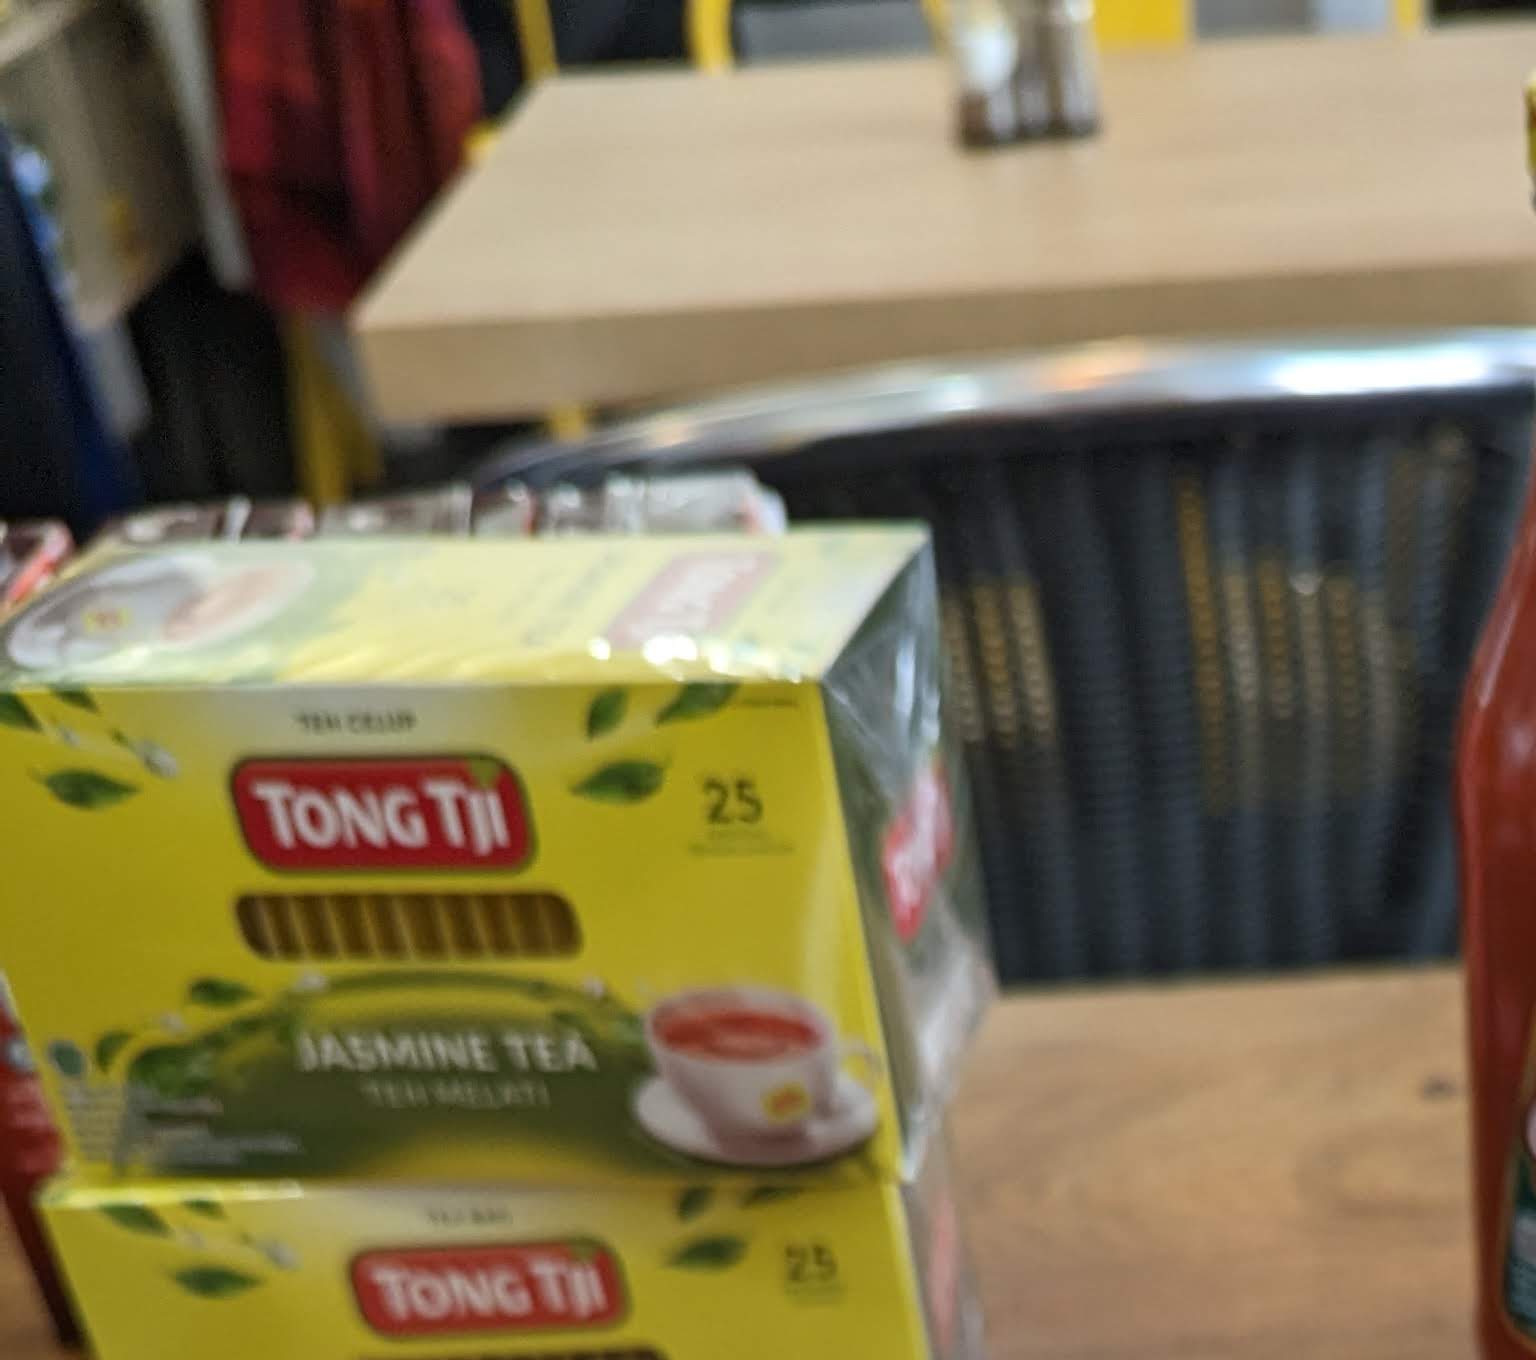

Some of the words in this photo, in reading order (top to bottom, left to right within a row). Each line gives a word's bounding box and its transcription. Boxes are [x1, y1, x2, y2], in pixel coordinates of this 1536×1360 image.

[254, 780, 429, 849] TONG
[703, 775, 764, 825] 25
[297, 1031, 497, 1072] JASMINE
[503, 1029, 598, 1072] TEA
[784, 1245, 838, 1283] 25
[370, 1266, 534, 1322] TONG
